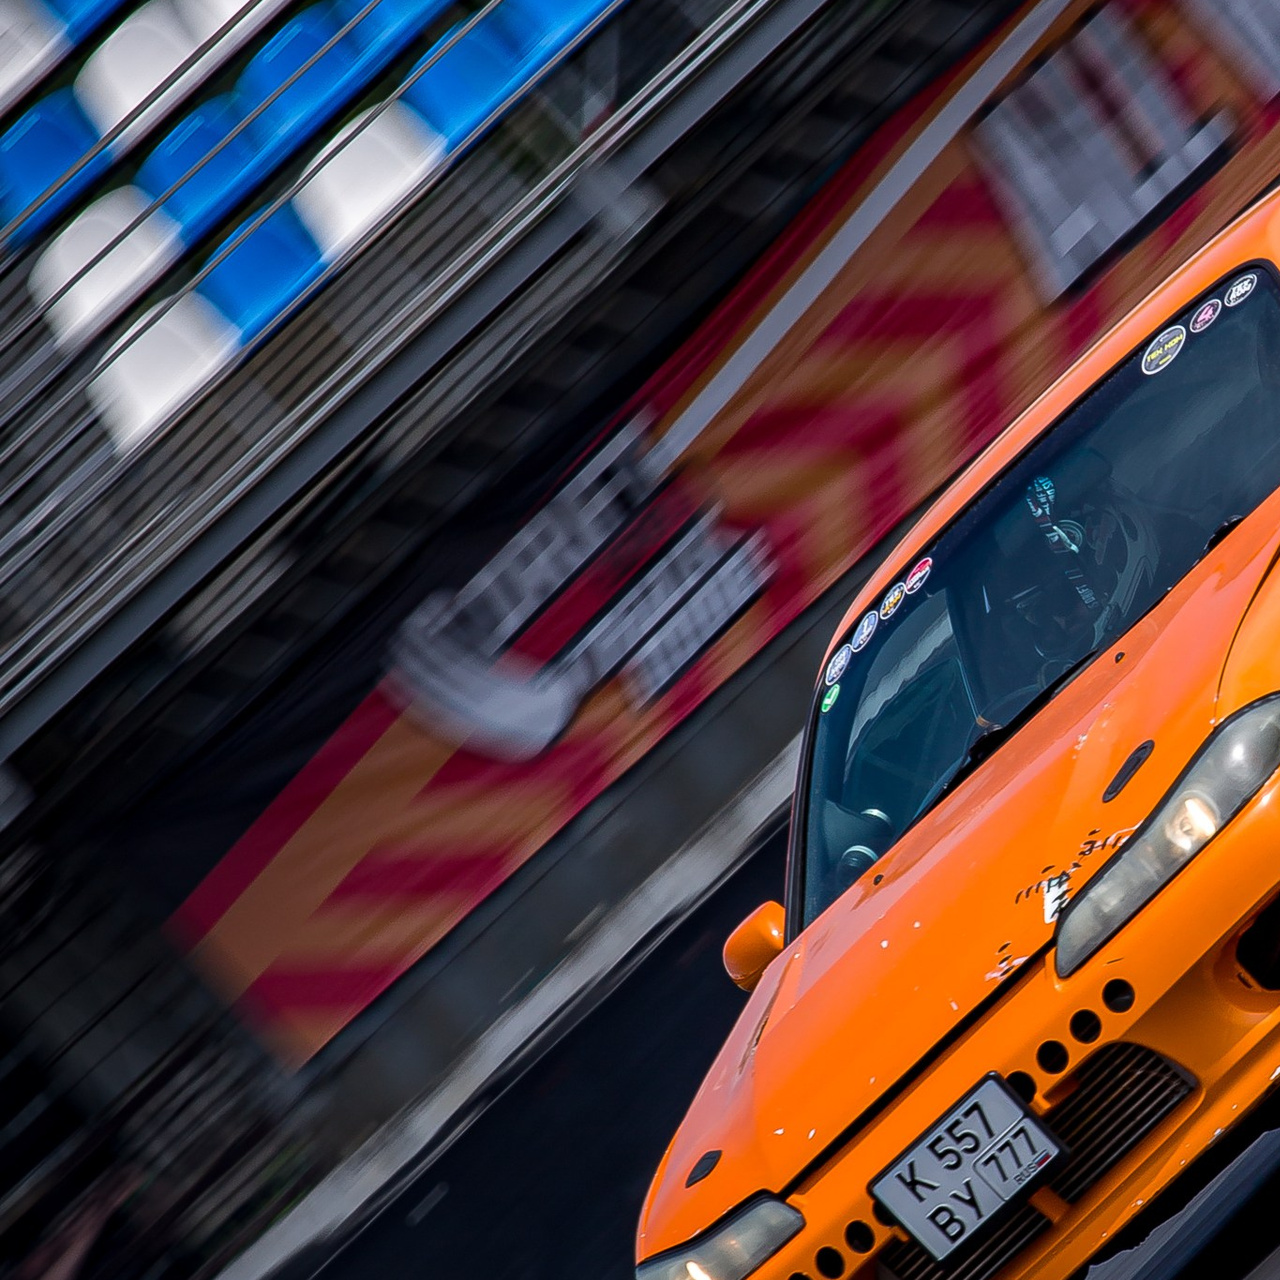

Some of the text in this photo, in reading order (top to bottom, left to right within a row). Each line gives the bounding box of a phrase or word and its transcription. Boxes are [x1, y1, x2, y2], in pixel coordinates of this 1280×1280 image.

[926, 1100, 996, 1170] 557
[981, 1125, 1038, 1183] 777
[1013, 1162, 1039, 1185] RUS
